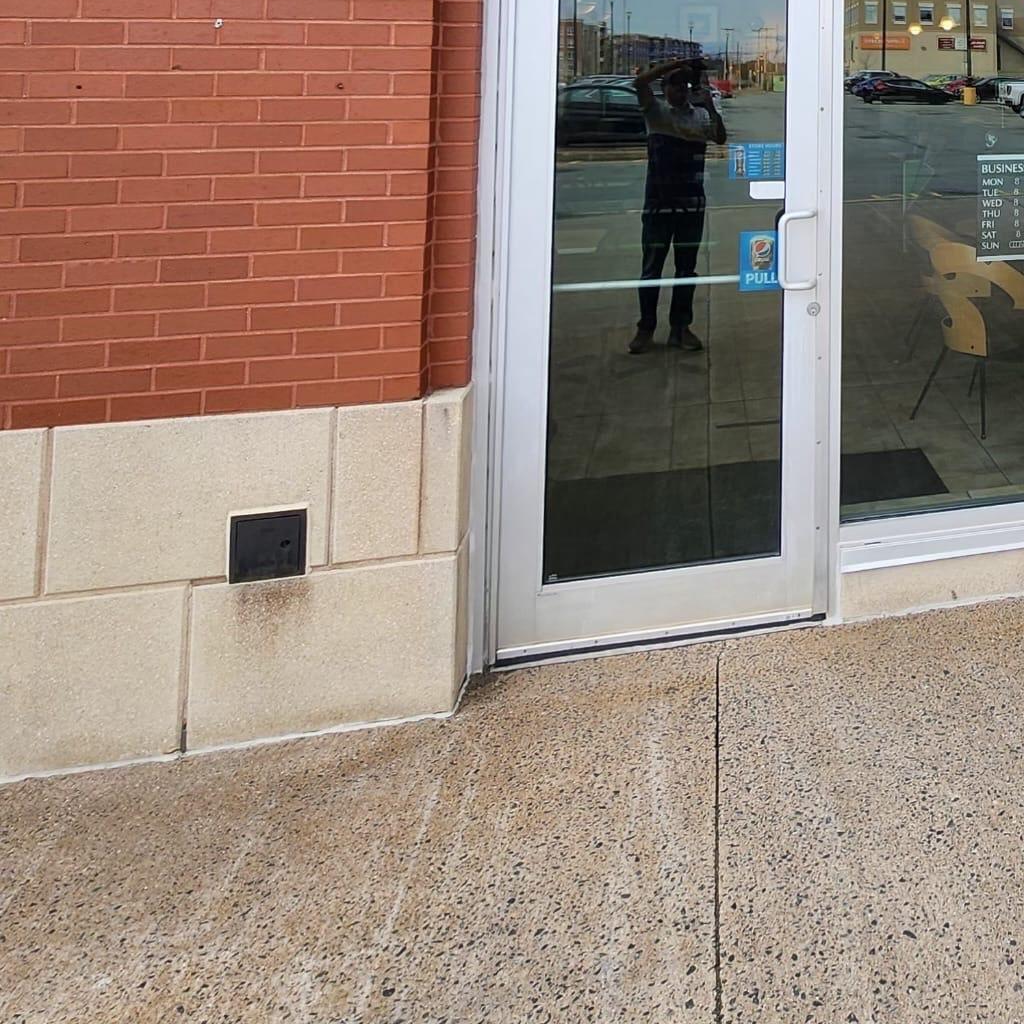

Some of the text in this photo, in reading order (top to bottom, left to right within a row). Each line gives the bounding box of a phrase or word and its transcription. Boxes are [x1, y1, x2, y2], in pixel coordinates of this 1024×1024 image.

[982, 178, 1004, 186] MON
[1014, 177, 1020, 185] 8
[982, 189, 1000, 197] TUE
[982, 199, 1003, 207] WED
[1013, 198, 1019, 206] 8
[982, 209, 1001, 218] THU
[1014, 208, 1019, 216] 8
[981, 220, 995, 229] FRI
[1014, 219, 1020, 227] 8
[981, 230, 997, 239] SAT
[981, 241, 1000, 250] SUN
[745, 272, 778, 285] PULL
